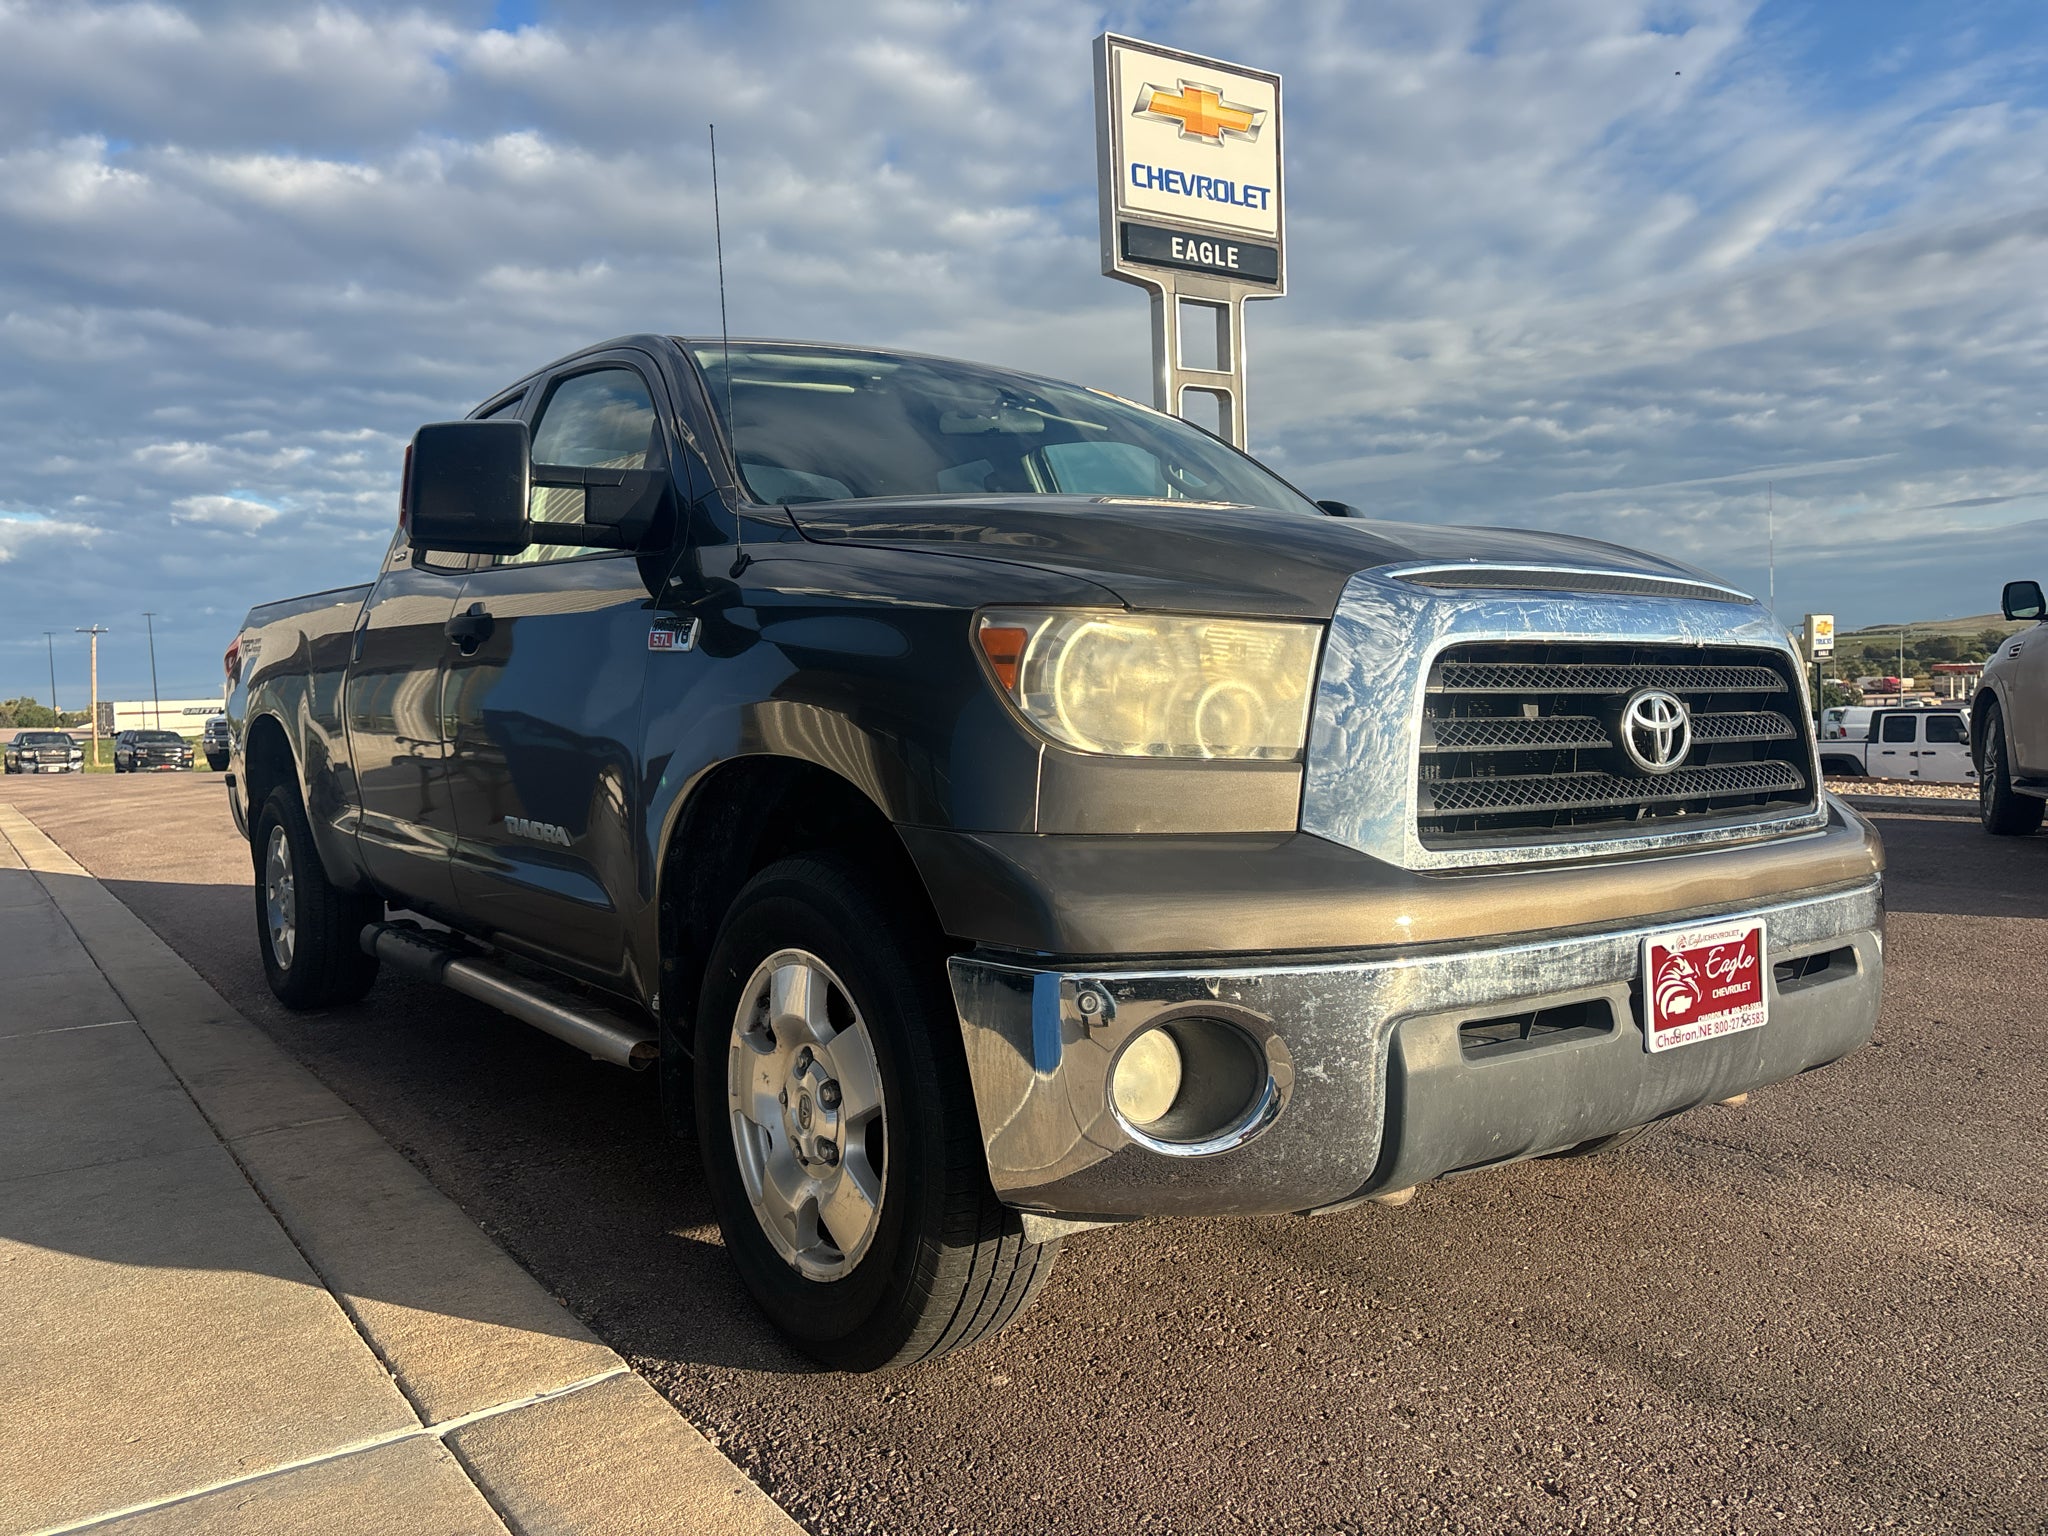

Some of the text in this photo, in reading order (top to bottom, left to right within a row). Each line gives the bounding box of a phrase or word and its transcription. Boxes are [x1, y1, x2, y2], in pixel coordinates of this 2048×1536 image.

[1131, 162, 1271, 210] CHEVROLET
[1171, 236, 1240, 269] EAGLE
[504, 815, 571, 847] TUNDRA
[1704, 943, 1755, 983] Eagle
[1712, 981, 1752, 998] CHEVROLET
